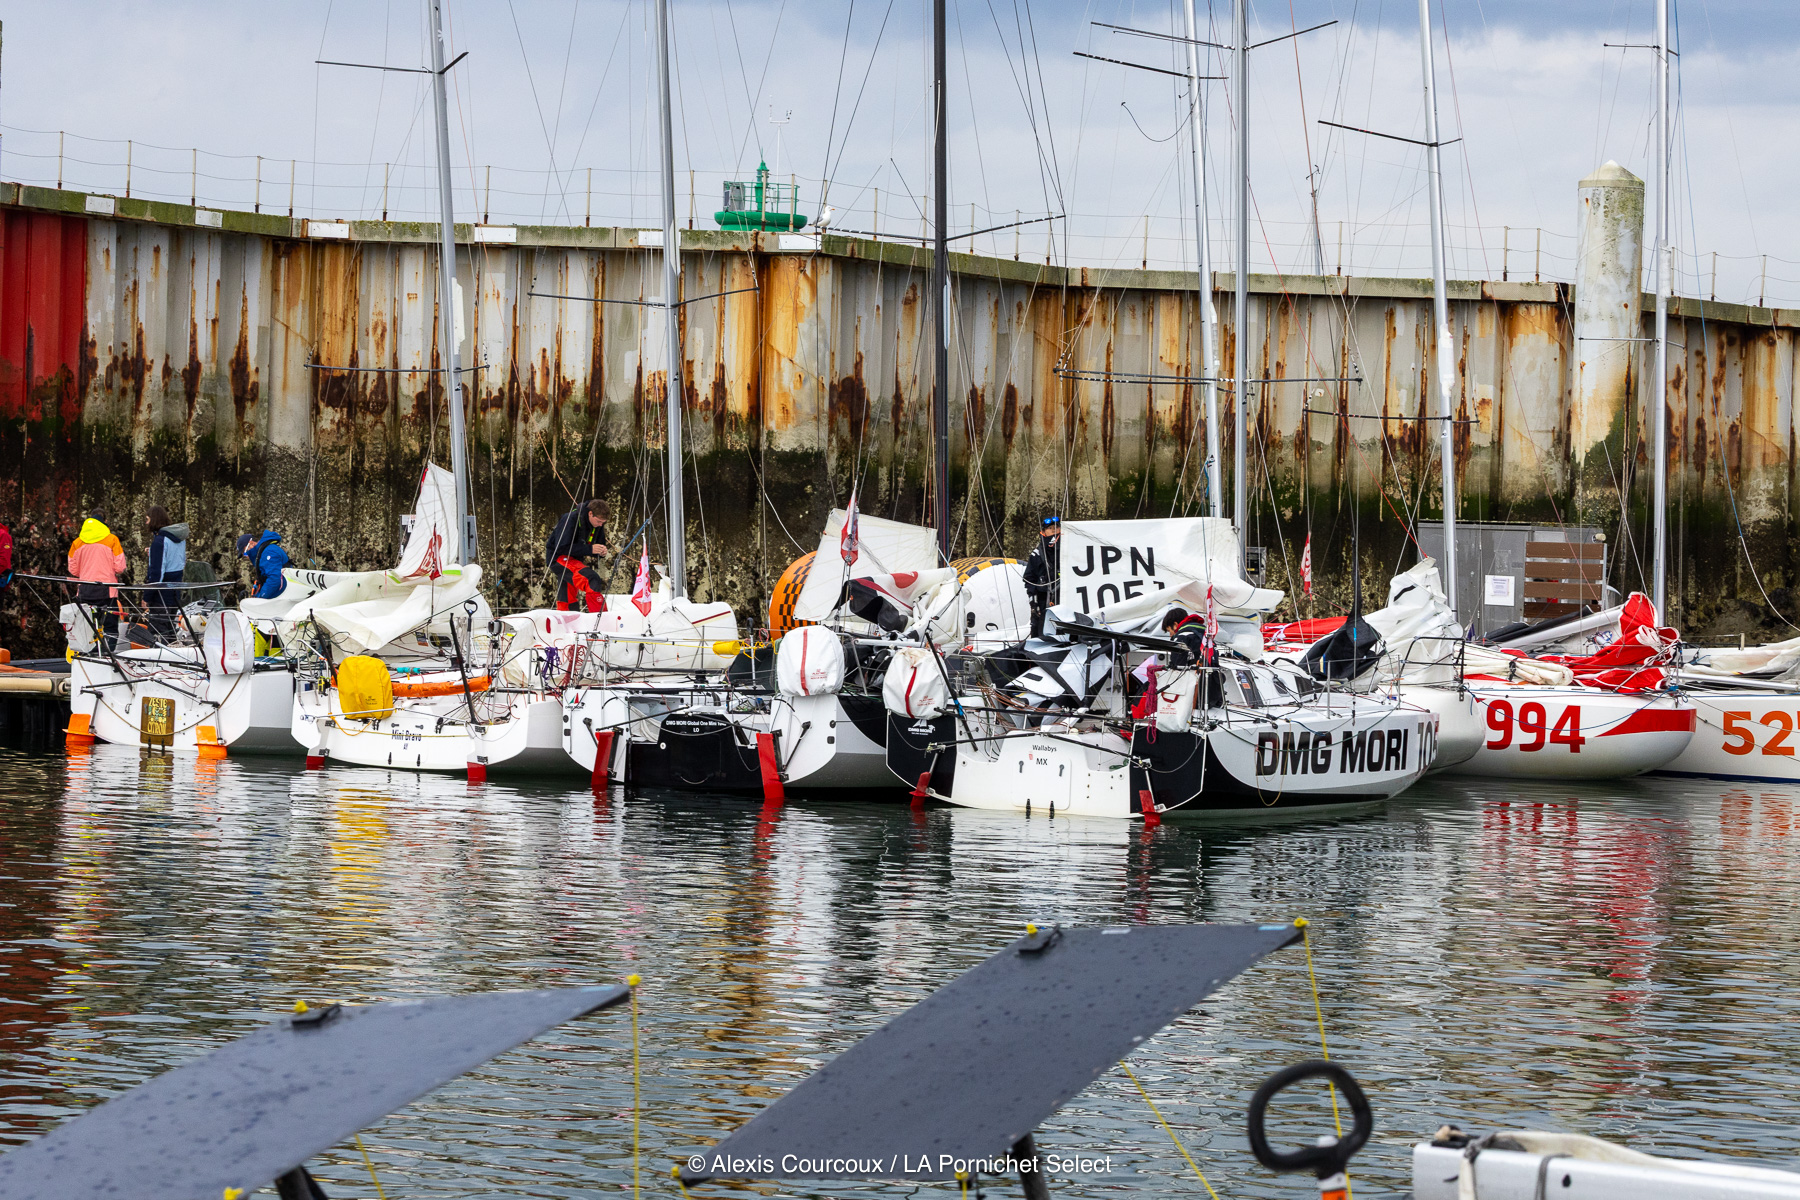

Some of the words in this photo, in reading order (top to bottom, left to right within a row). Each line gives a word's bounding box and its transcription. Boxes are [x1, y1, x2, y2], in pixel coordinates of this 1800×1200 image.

[1072, 545, 1155, 577] JPN
[1076, 579, 1166, 615] 105
[1486, 699, 1586, 754] 994
[1721, 710, 1800, 756] 52
[1032, 744, 1057, 753] Wallabys
[1036, 757, 1048, 766] MX
[1255, 731, 1332, 776] DMG
[1340, 728, 1408, 774] MORI
